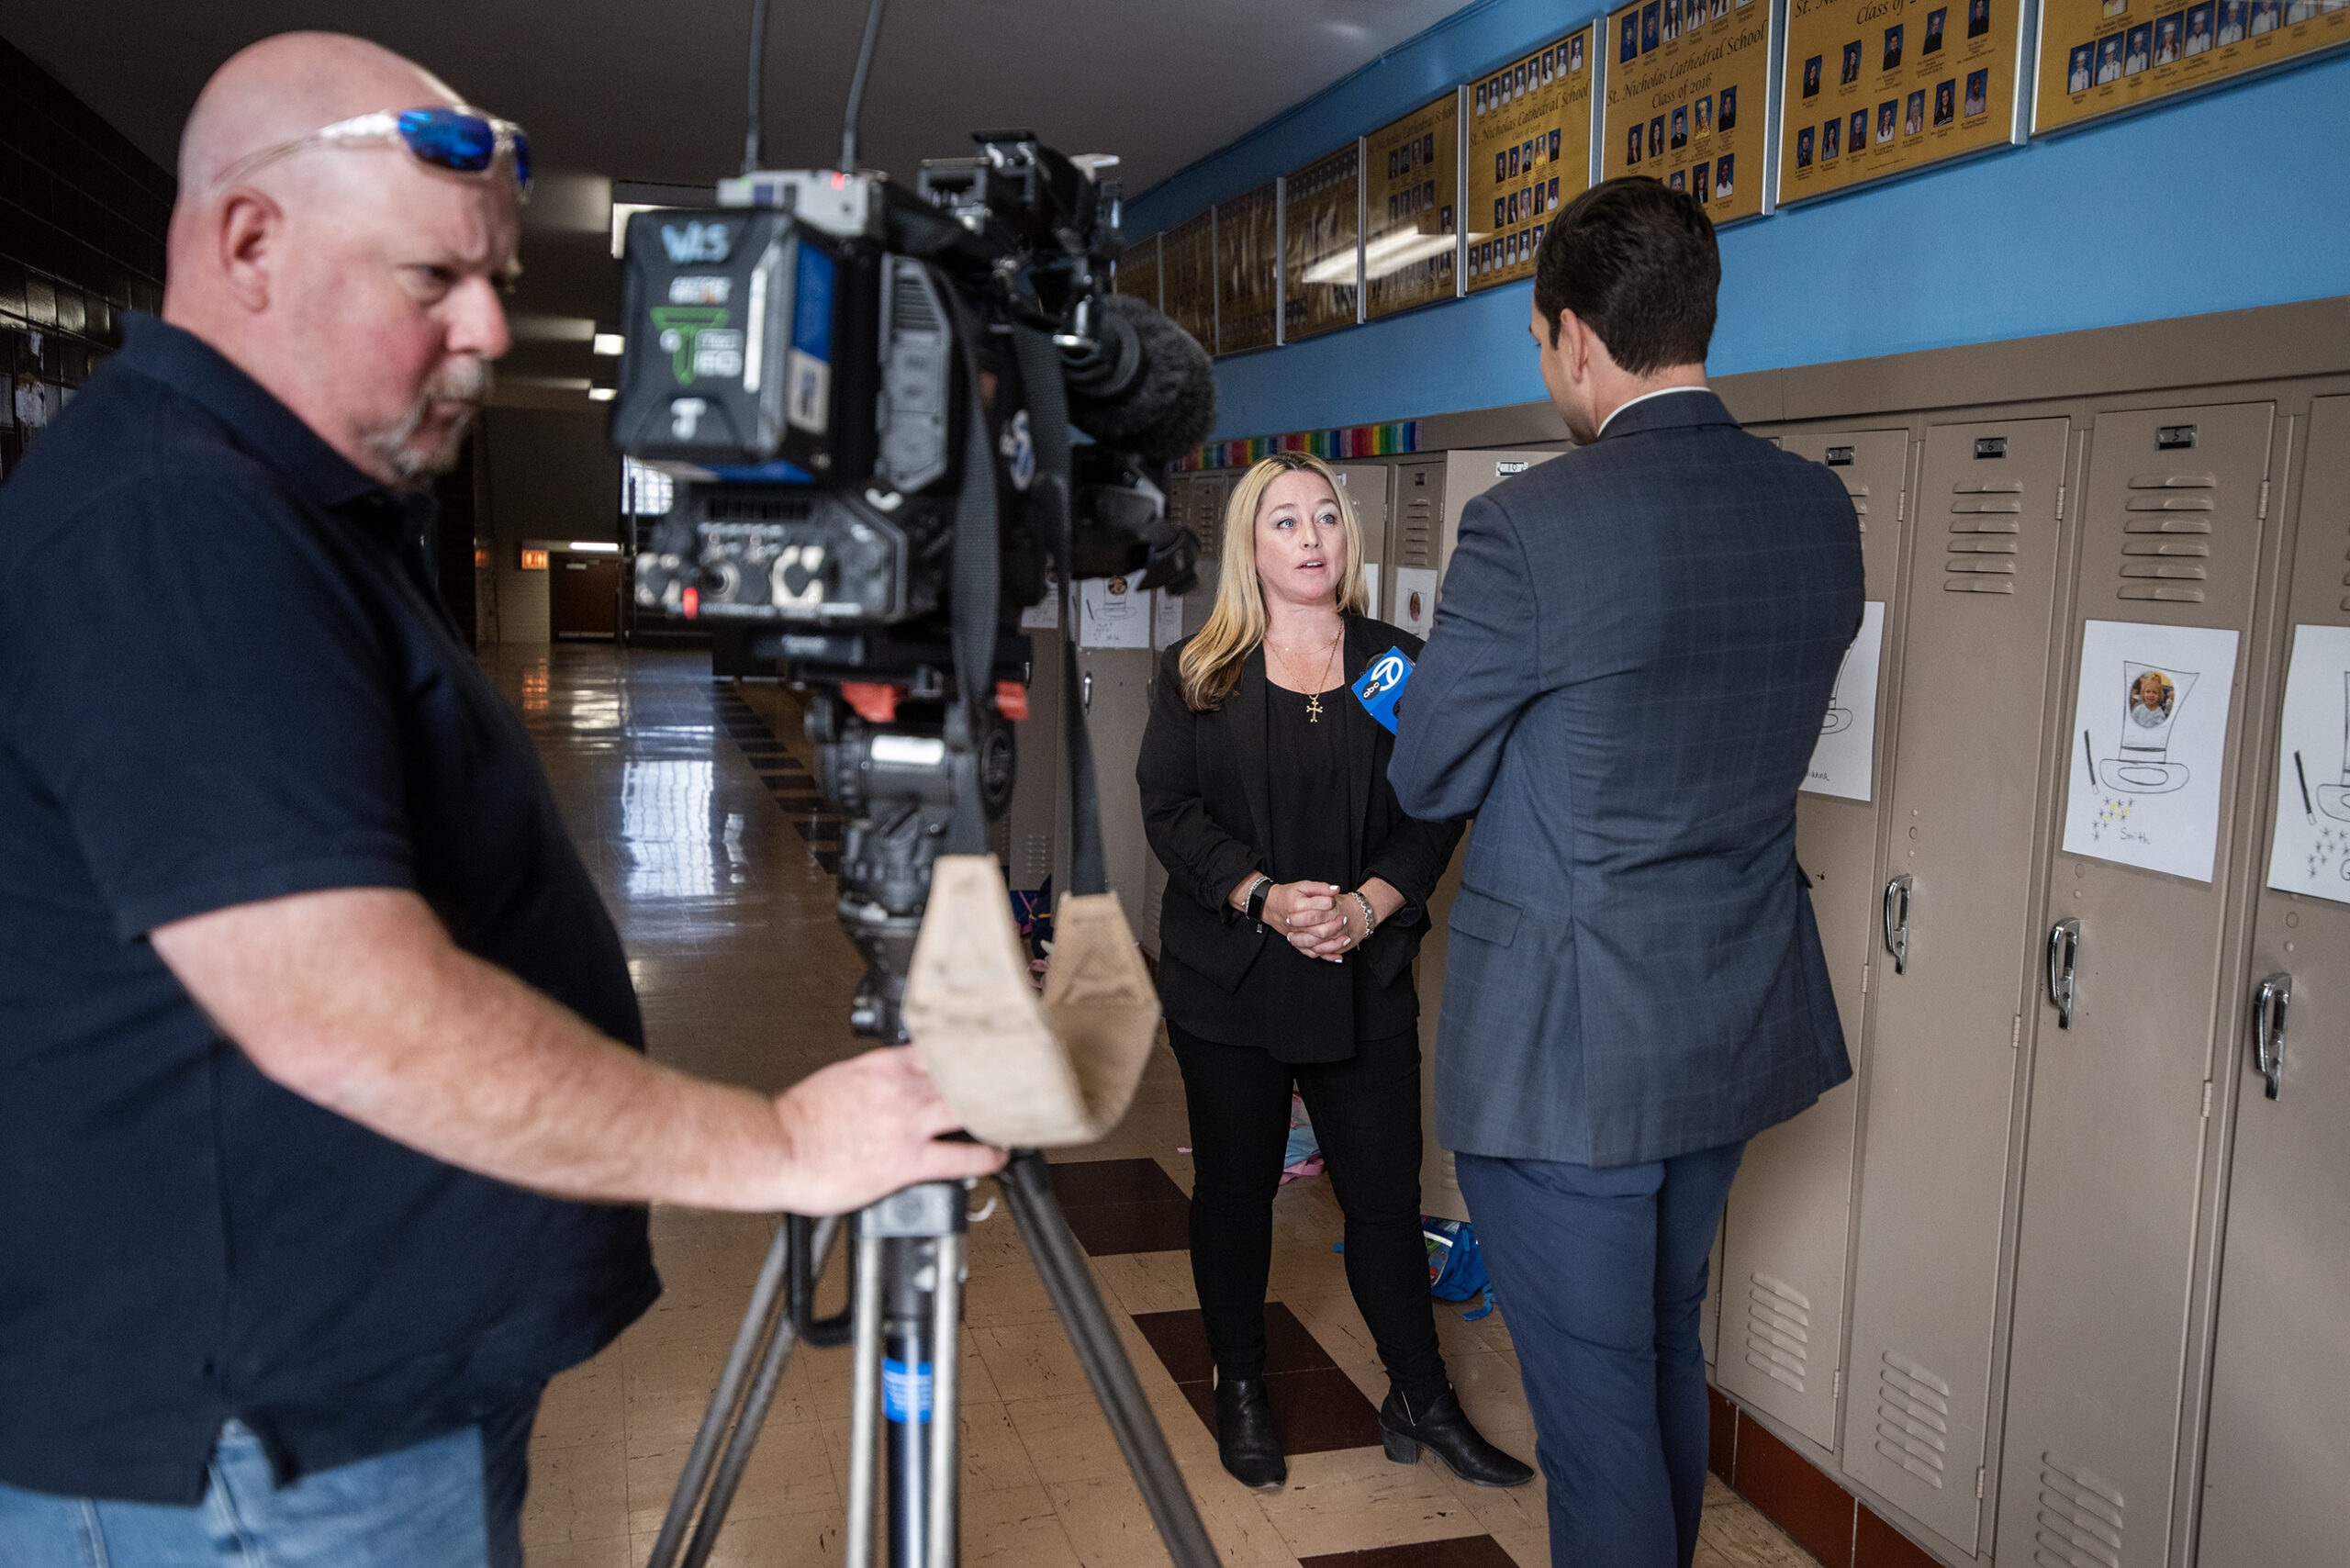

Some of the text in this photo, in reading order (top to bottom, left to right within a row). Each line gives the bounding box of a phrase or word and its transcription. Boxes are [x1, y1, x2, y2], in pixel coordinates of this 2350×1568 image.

[1856, 2, 1888, 25] Class
[1606, 89, 1619, 106] St.
[1622, 68, 1667, 101] Nicholas
[1670, 38, 1724, 80] Cathedral
[1727, 19, 1768, 55] School
[1652, 73, 1713, 109] Class of 2016
[1482, 116, 1516, 143] Nicholas
[1517, 92, 1561, 126] Cathedral
[1561, 78, 1591, 109] School
[1987, 440, 1994, 452] 6
[1507, 463, 1518, 472] 10
[1363, 681, 1381, 700] abc
